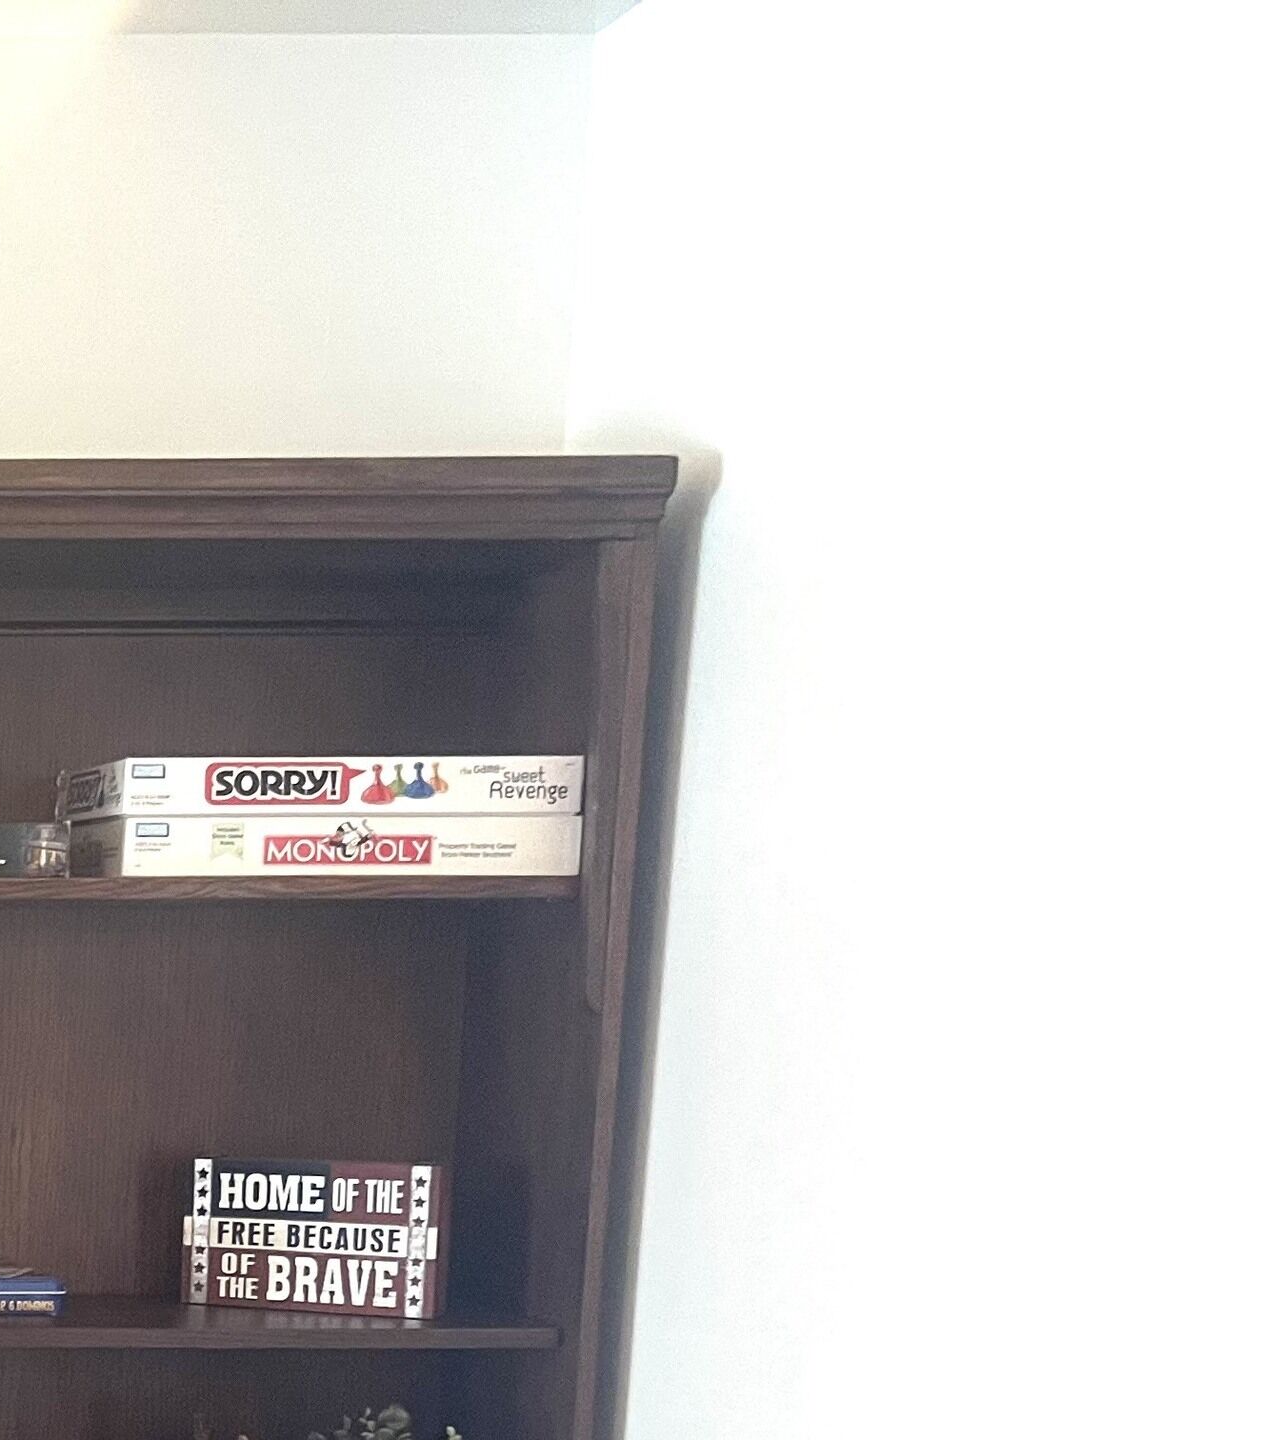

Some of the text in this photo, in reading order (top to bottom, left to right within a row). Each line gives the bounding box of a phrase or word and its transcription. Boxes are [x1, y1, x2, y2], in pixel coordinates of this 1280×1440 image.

[216, 770, 339, 796] SORRY!
[490, 781, 568, 804] Revenge
[266, 839, 429, 862] MONOPOLY
[218, 1173, 404, 1214] HOME OF THE
[217, 1221, 400, 1253] FREE BECAUSE
[221, 1252, 256, 1275] OF
[217, 1255, 399, 1308] THE BRAVE
